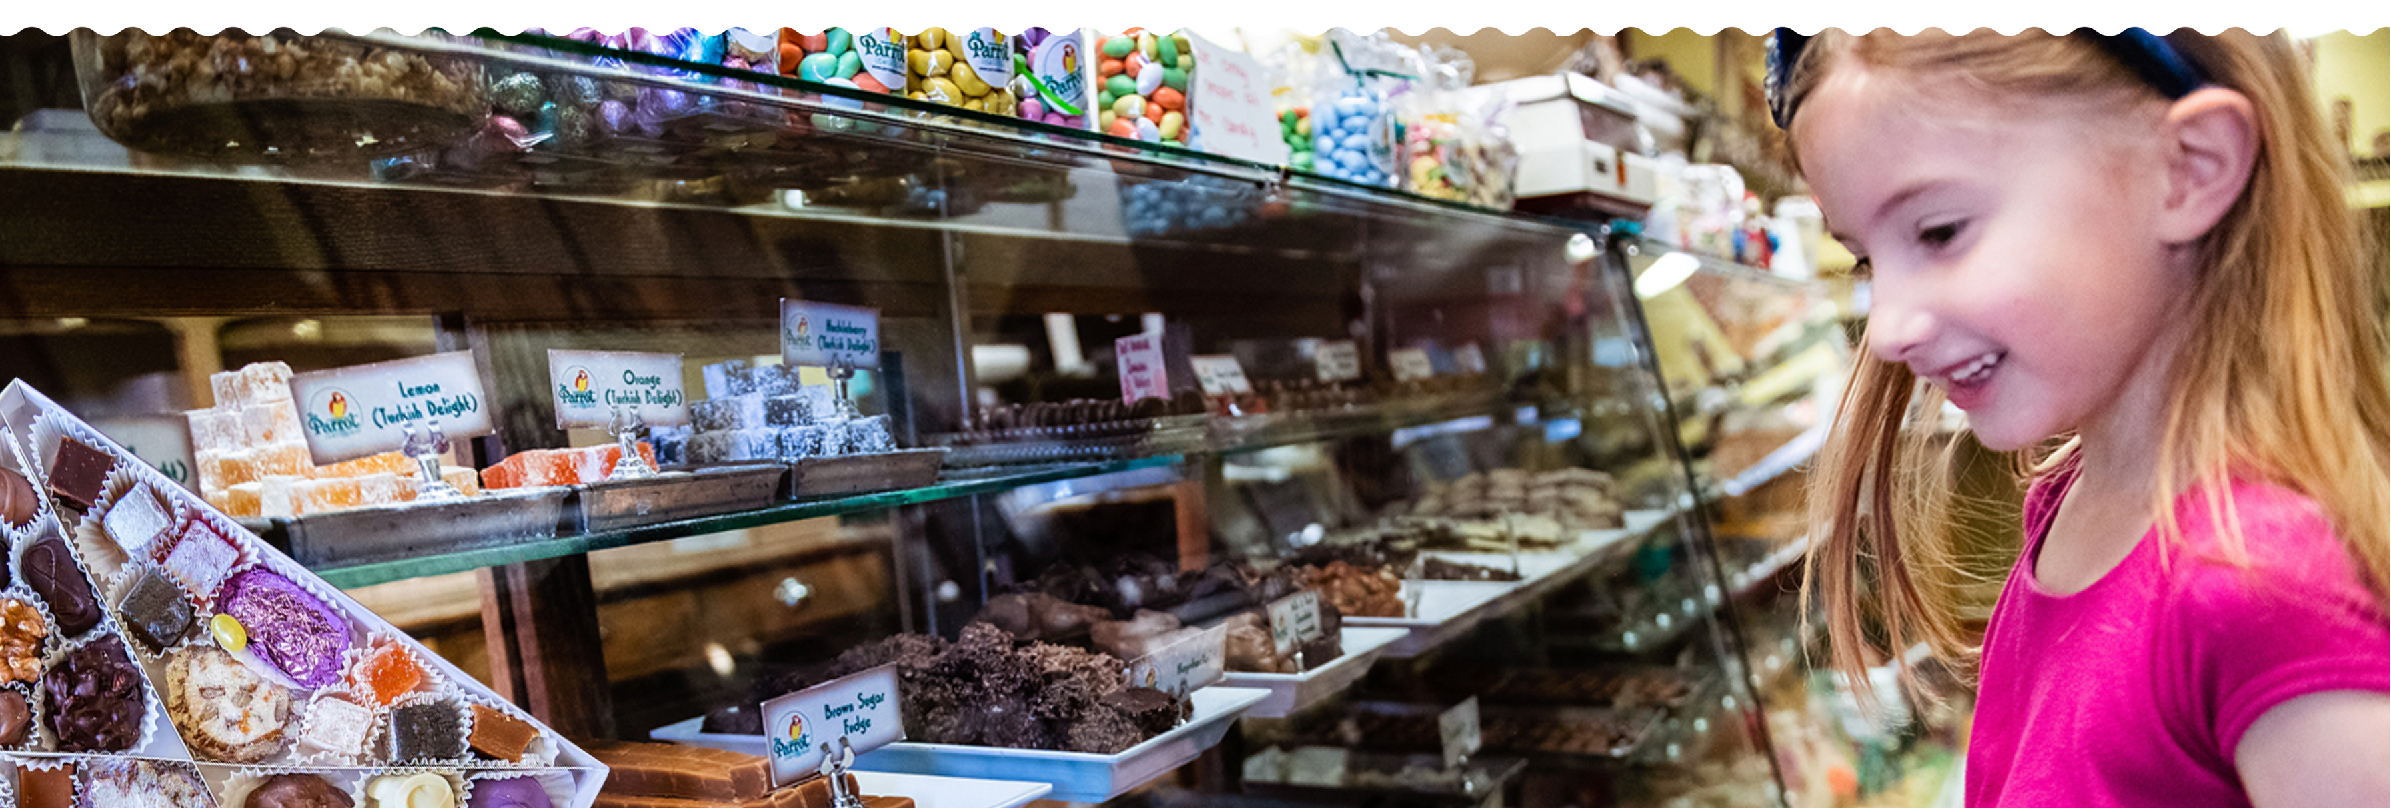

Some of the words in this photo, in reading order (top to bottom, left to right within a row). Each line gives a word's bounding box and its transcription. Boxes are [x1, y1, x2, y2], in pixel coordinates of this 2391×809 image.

[967, 38, 1010, 61] Parrot
[398, 381, 440, 398] Lemon
[622, 369, 661, 390] Orange
[557, 389, 596, 404] Parrot
[605, 388, 641, 405] (Turkish
[645, 388, 683, 409] Delight)
[372, 402, 423, 429] (Turkish
[426, 391, 478, 418] Delight)
[308, 412, 360, 435] Parrot
[823, 702, 854, 720] Brown
[857, 692, 885, 710] Sugar
[843, 715, 872, 735] Fudge
[773, 732, 811, 758] Parrot
